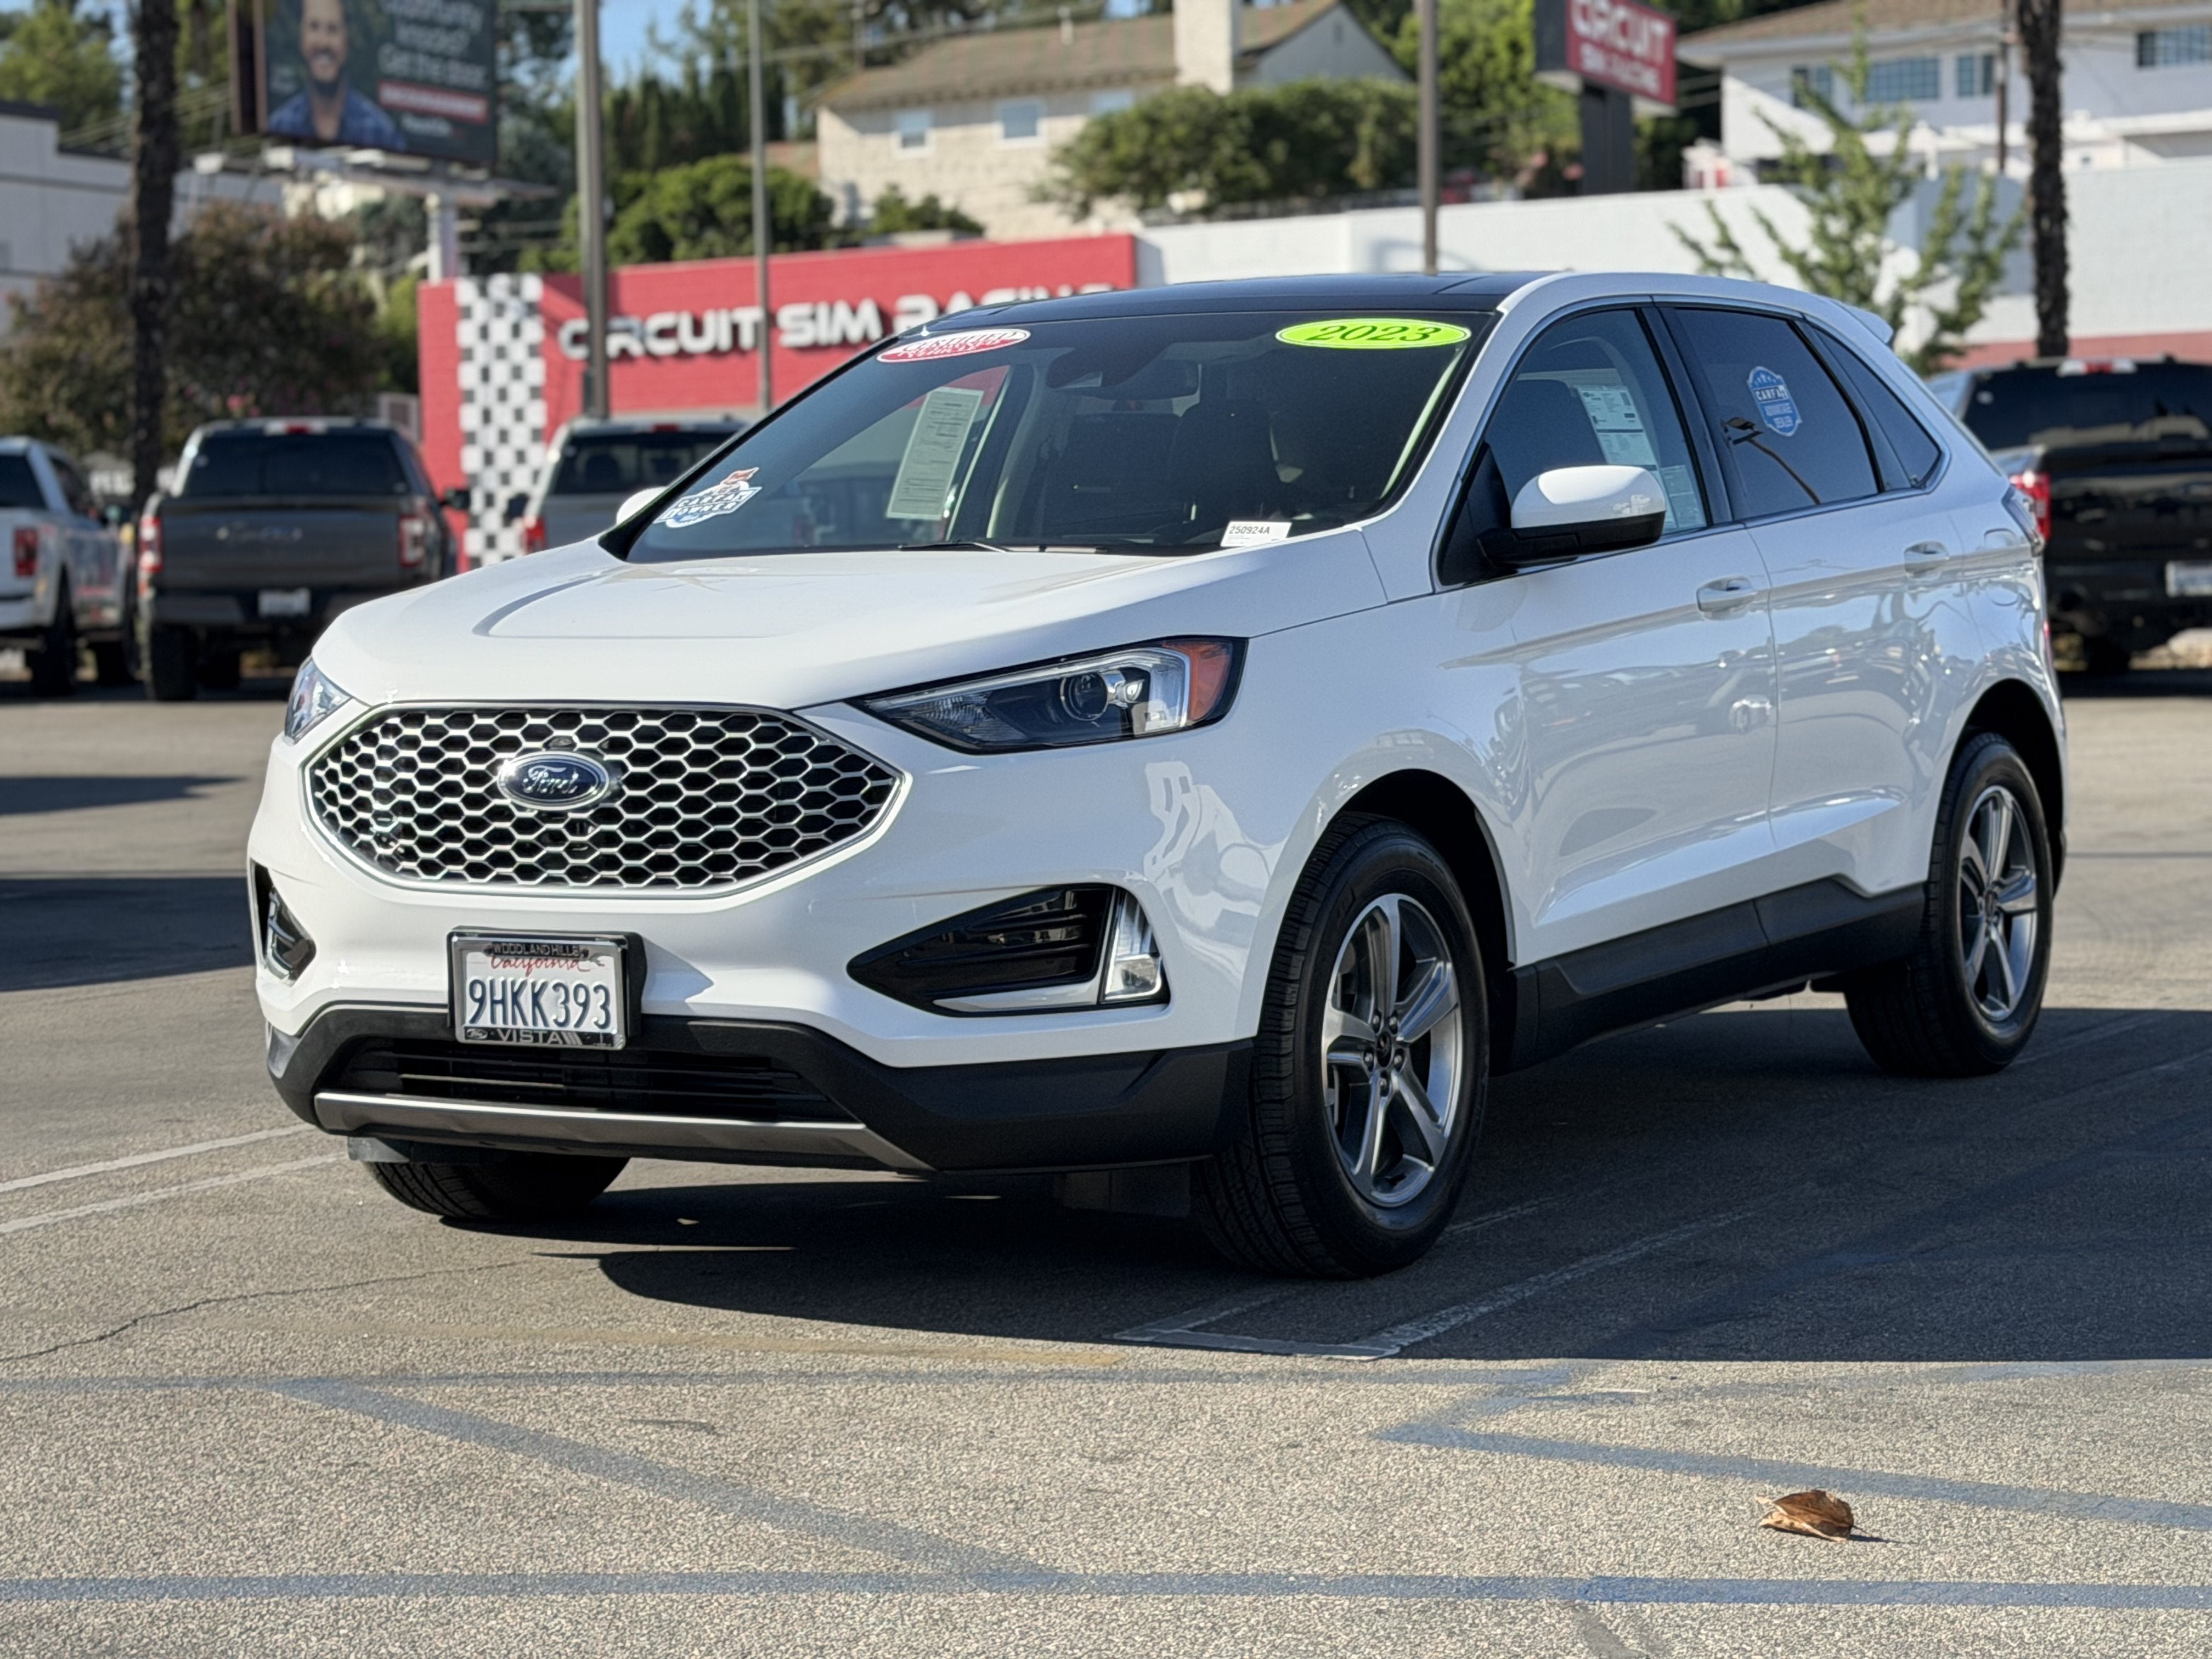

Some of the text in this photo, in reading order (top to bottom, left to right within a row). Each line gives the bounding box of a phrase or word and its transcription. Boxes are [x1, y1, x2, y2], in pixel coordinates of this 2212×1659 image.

[557, 306, 764, 360] CRCUIT
[776, 298, 882, 348] SIM
[1305, 325, 1442, 342] 2023
[1229, 526, 1271, 534] 250924A
[523, 765, 578, 794] Ford
[494, 943, 580, 957] WOODLAND HILLS
[469, 979, 611, 1029] 9HKK393
[497, 1029, 563, 1045] VISTA
